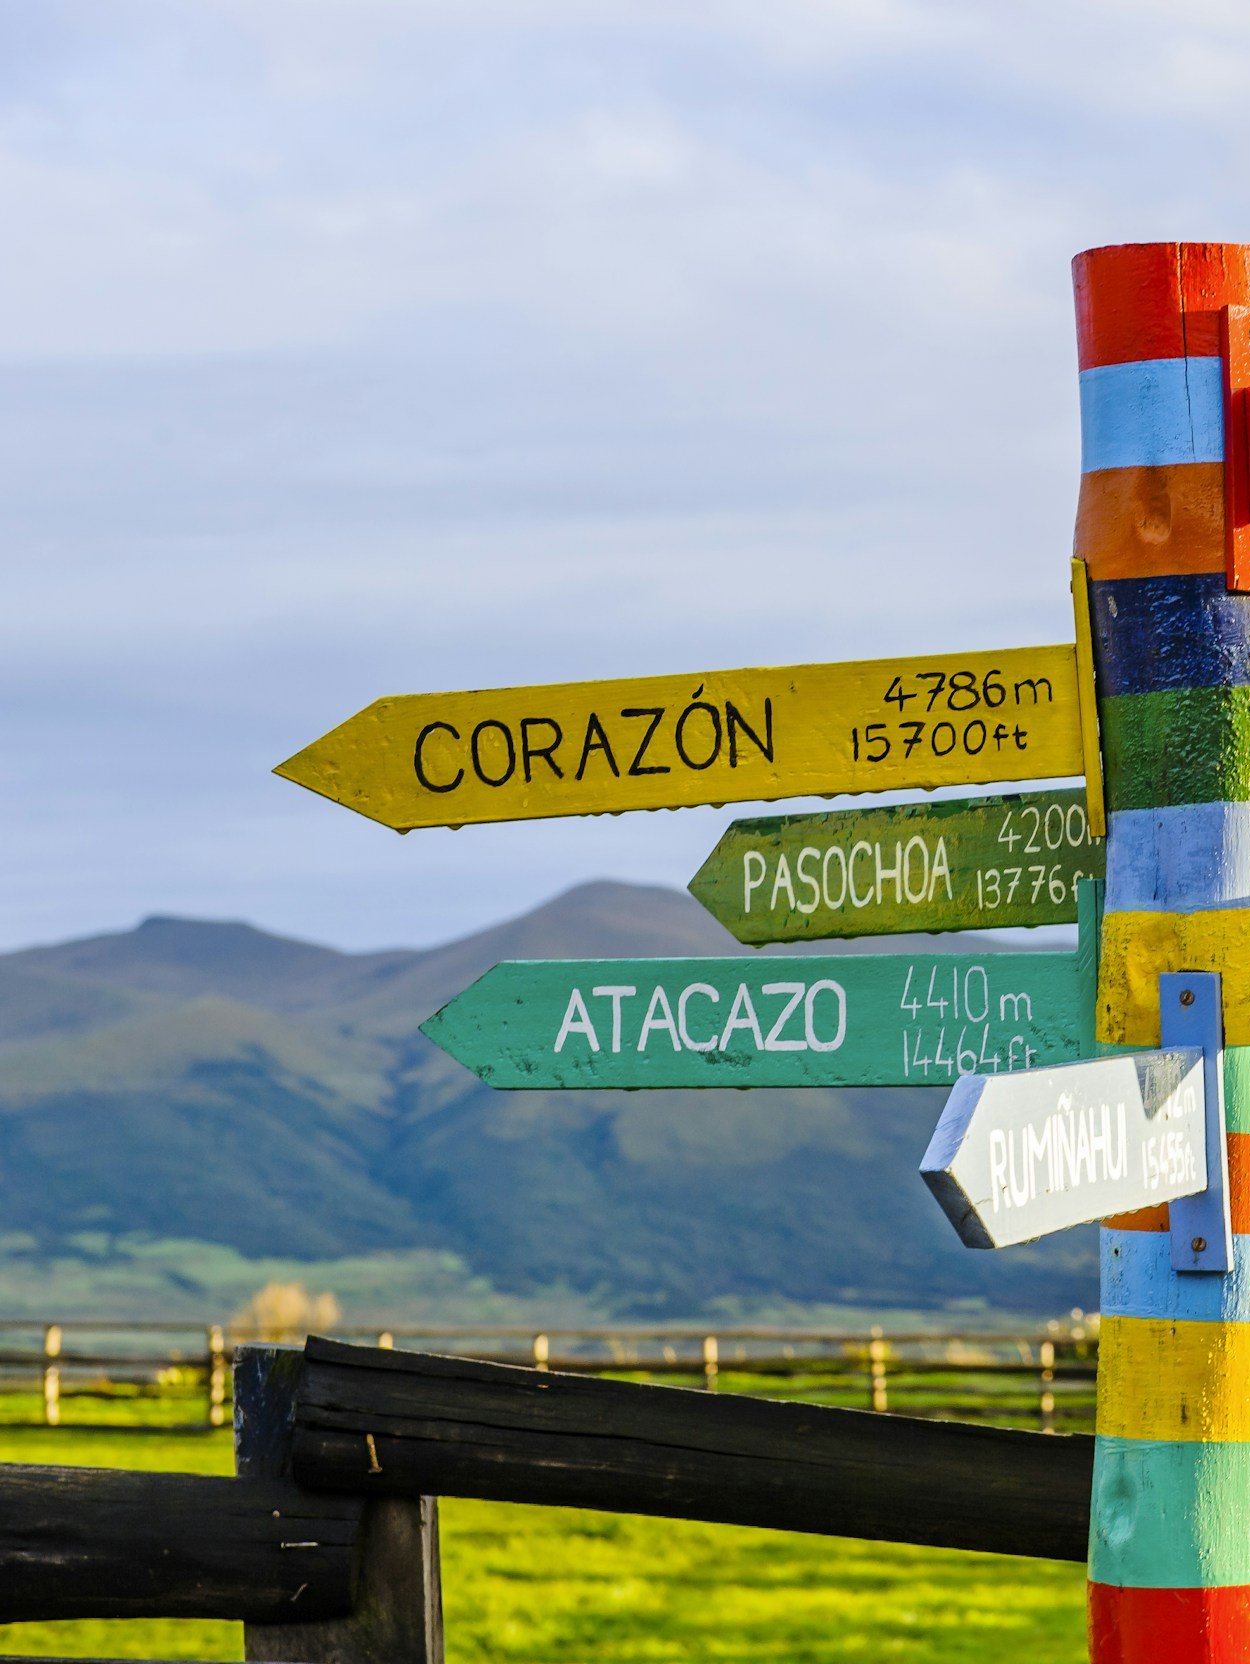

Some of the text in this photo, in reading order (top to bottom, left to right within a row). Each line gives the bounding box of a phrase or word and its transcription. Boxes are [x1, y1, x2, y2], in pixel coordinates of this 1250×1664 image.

[414, 683, 774, 793] CORAZÓN
[852, 719, 1028, 762] 15700ft
[743, 835, 953, 914] PASOCHOA
[977, 864, 1093, 910] 13776f
[553, 979, 847, 1052] ATACAZO
